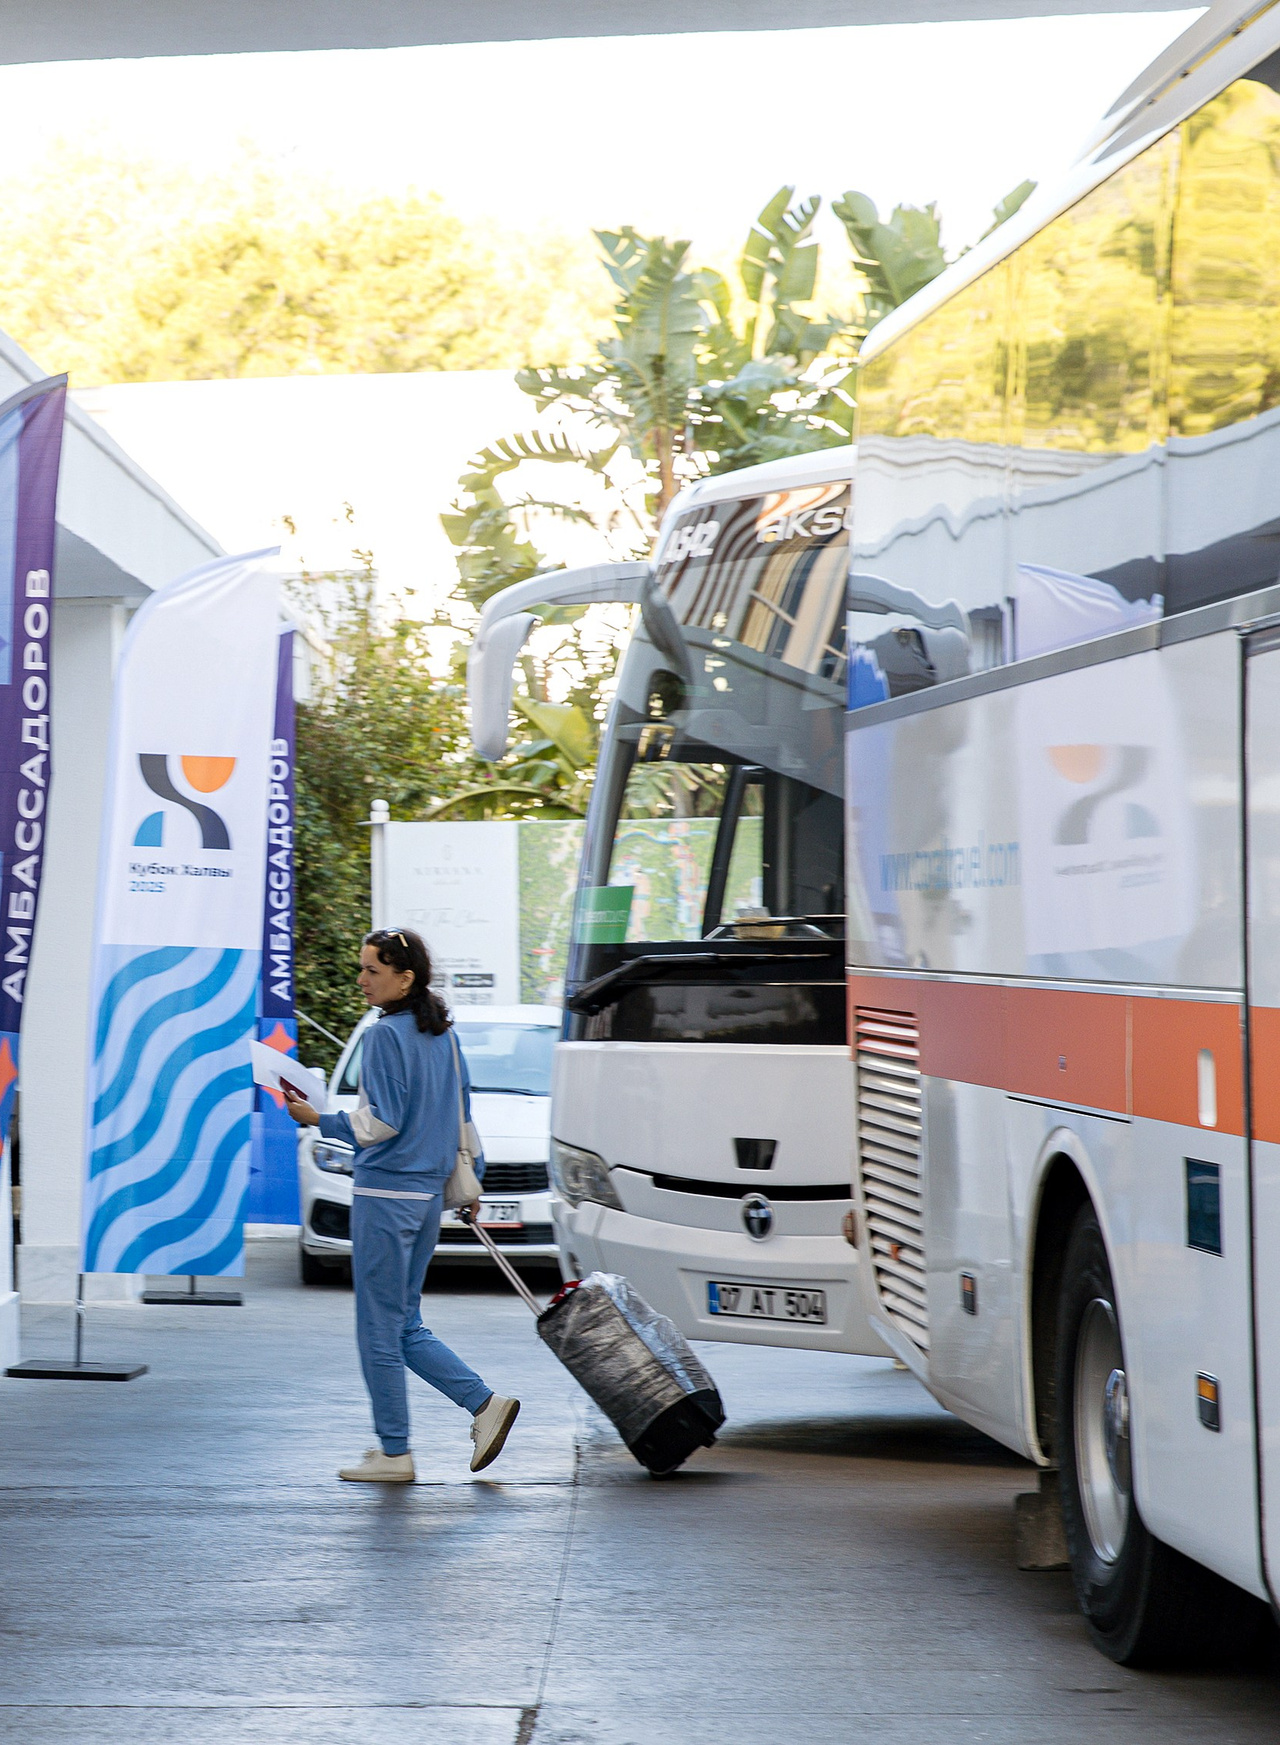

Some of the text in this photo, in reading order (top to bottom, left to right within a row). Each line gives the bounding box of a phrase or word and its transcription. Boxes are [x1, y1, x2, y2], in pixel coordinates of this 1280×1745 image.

[1, 568, 51, 1003] АМБАССАДОРОВ
[128, 862, 233, 878] Кубок Халвы
[129, 880, 165, 892] 2025
[268, 738, 293, 1001] АМБАССАДОРОВ
[719, 1286, 824, 1319] 07 AT 504
